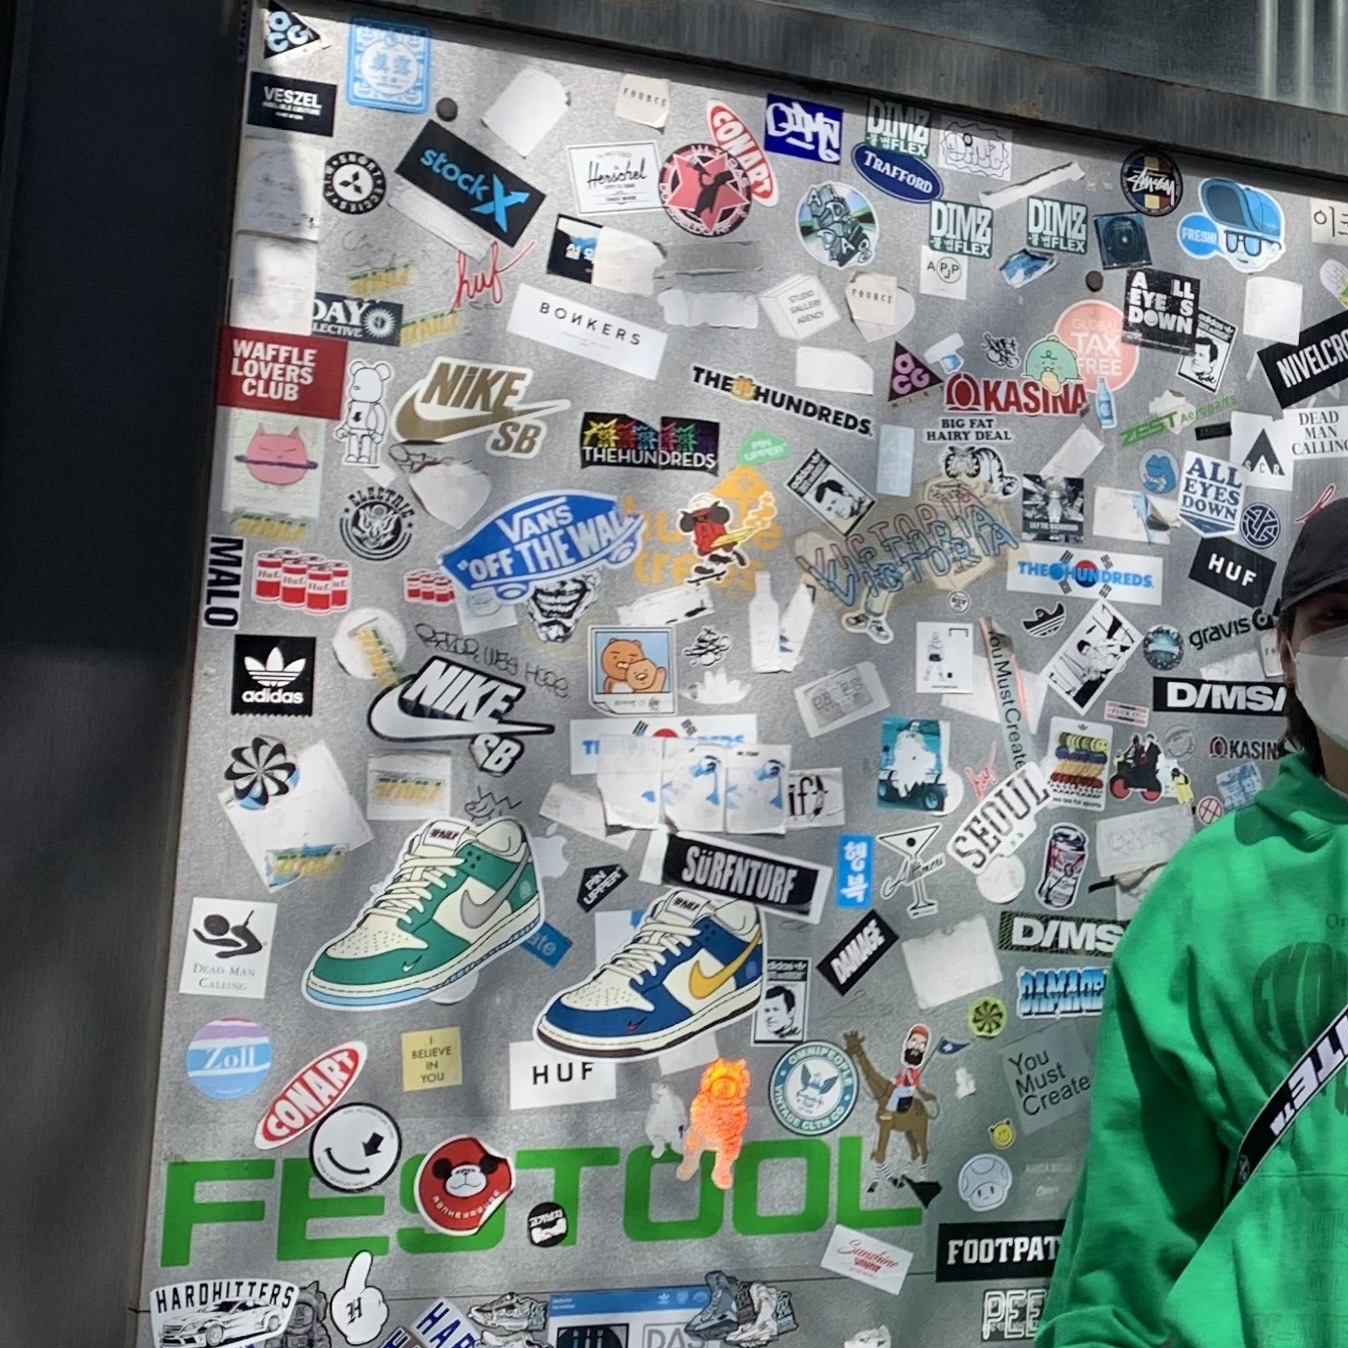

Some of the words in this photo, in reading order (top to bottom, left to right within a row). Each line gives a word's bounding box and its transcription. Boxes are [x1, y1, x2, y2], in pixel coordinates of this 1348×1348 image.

[264, 86, 322, 109] VESZEL
[867, 99, 931, 145] DIMZ
[710, 104, 773, 199] CONART
[891, 139, 928, 158] FLEX
[587, 157, 648, 189] Herschel
[863, 150, 933, 194] TRAFFORD
[420, 147, 531, 234] stockX
[930, 202, 993, 245] DIMZ
[1028, 197, 1088, 243] DIMZ
[953, 239, 990, 258] FLEX
[1050, 235, 1086, 254] FLEX
[1128, 306, 1193, 335] DOWN
[232, 339, 317, 367] WAFFLE
[1073, 332, 1121, 359] TAX
[231, 357, 314, 386] LOVERS
[693, 366, 733, 393] THE
[1077, 356, 1122, 377] FREE
[240, 379, 300, 402] CLUB
[423, 361, 527, 412] NIKE
[982, 379, 1089, 415] KASINA
[941, 418, 966, 429] BIG
[970, 418, 994, 429] FAT
[1299, 410, 1339, 426] DEAD
[1304, 425, 1338, 440] MAN
[493, 420, 542, 455] SB
[926, 429, 973, 442] HAIRY
[976, 429, 1012, 442] DEAL
[1186, 456, 1243, 488] ALL
[1184, 477, 1240, 507] EYES
[494, 496, 574, 544] VANS
[1182, 495, 1238, 523] DOWN
[514, 527, 576, 574] THE
[204, 535, 244, 627] MALO
[1018, 560, 1049, 577] THE
[1066, 566, 1153, 588] HUNDREDS
[1207, 553, 1258, 587] HUF
[1188, 616, 1251, 651] gravis
[242, 689, 303, 705] adidas
[402, 661, 519, 726] NIKE
[473, 733, 524, 774] SB
[952, 768, 1050, 869] SEOUL
[193, 963, 225, 977] DEAD
[228, 967, 256, 979] MAN
[411, 1045, 453, 1060] BELIEVE
[425, 1060, 439, 1071] IN
[1009, 1049, 1050, 1076] You
[420, 1071, 445, 1084] YOU
[531, 1061, 595, 1085] HUF
[1014, 1064, 1066, 1099] Must
[265, 1048, 357, 1139] CONART
[774, 1083, 804, 1129] VINTAGE
[1022, 1073, 1091, 1117] Create
[160, 1135, 923, 1268] FESTOOL
[837, 1238, 899, 1270] Sunshine
[155, 1280, 295, 1314] HARDHITTERS
